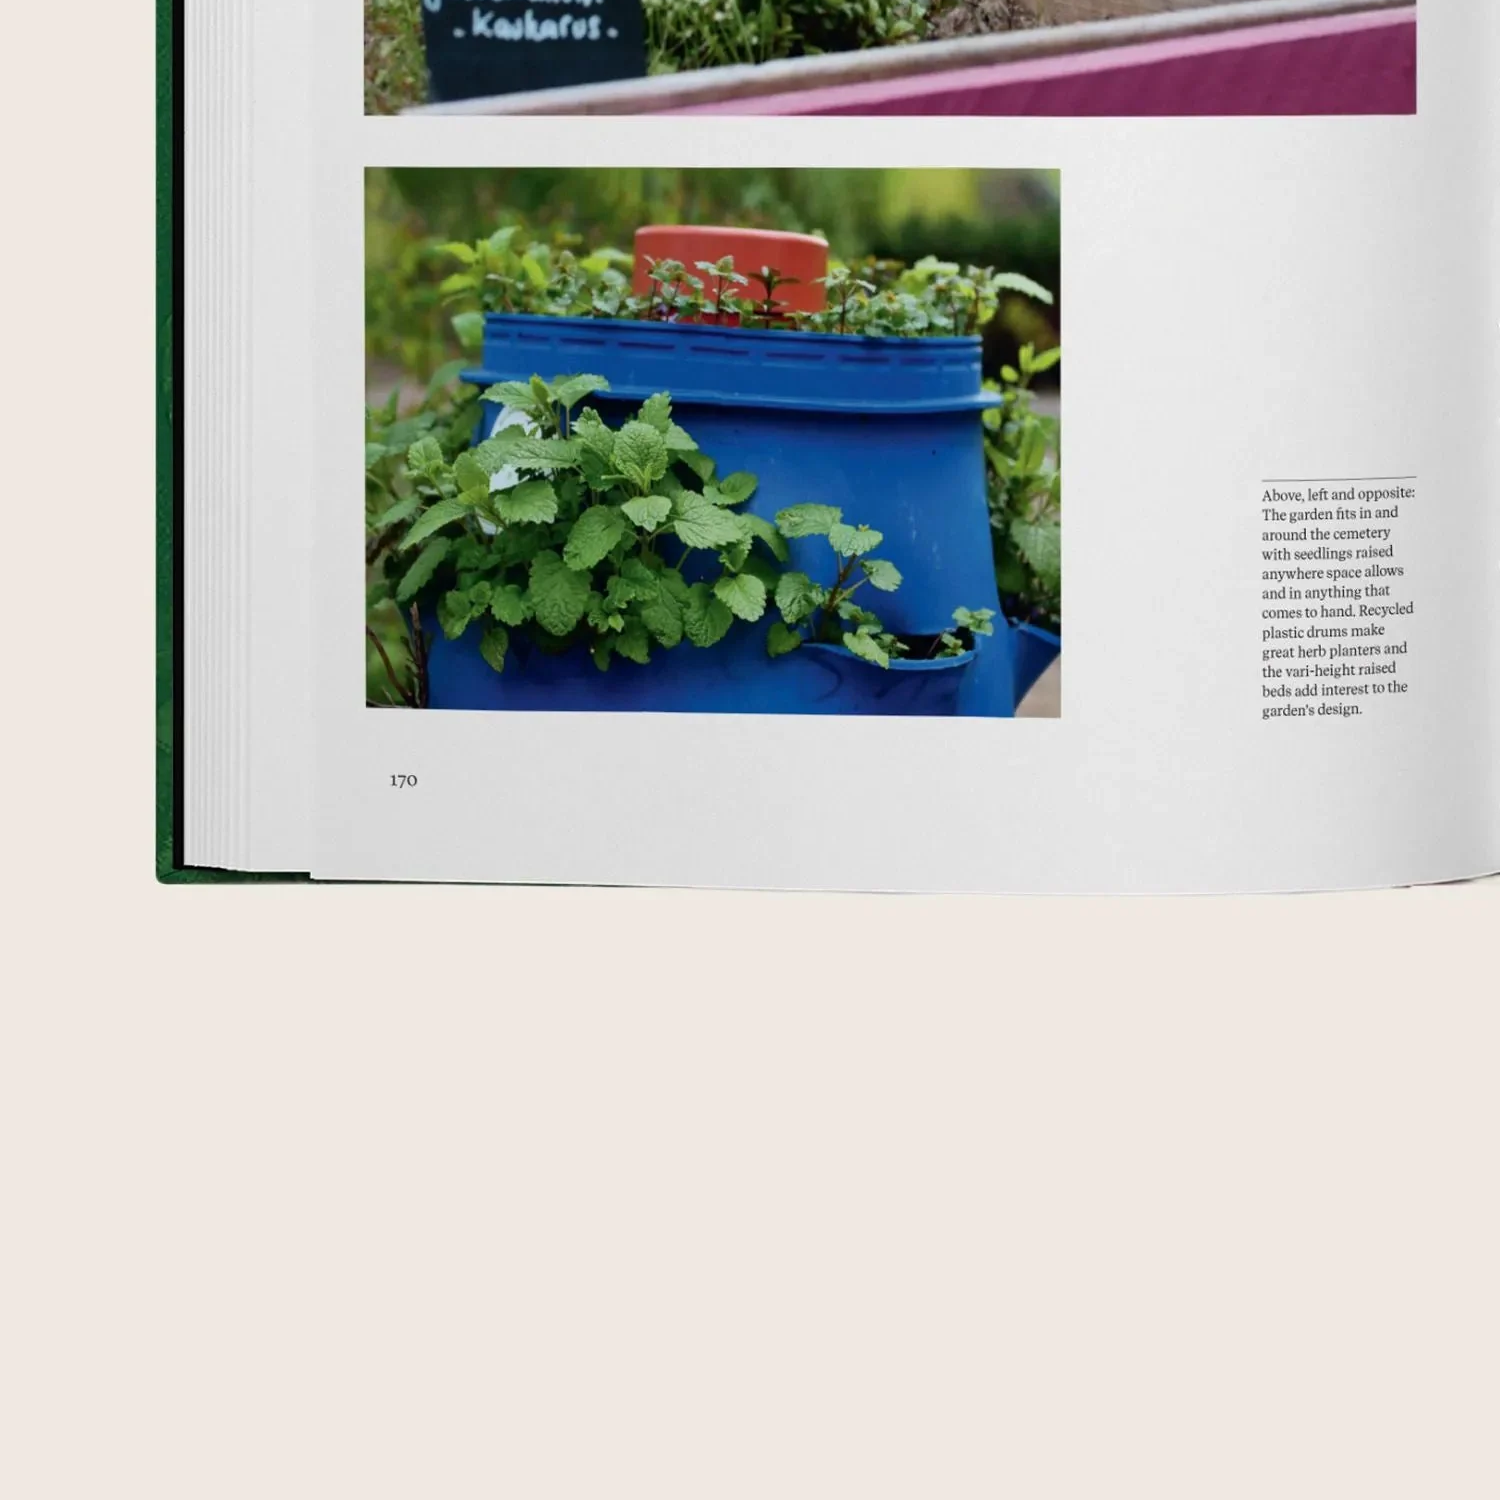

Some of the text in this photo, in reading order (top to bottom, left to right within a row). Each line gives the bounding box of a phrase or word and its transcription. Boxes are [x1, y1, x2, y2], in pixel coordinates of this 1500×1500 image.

[1262, 486, 1416, 503] Above, left and opposite:
[1262, 506, 1398, 523] The garden fits in and
[1262, 527, 1391, 541] around the cemetery
[1262, 545, 1394, 561] with seedlings raised
[1262, 565, 1404, 583] anywhere space allows
[1262, 585, 1390, 601] and in anything that
[1262, 602, 1414, 619] comes to hand. Recycled
[1262, 624, 1385, 641] plastic drums make
[1262, 642, 1407, 661] great herb planters and
[1262, 662, 1396, 679] the vari-height raised
[1262, 681, 1408, 697] beds add interest to the
[1262, 703, 1363, 719] garden's design.
[390, 774, 418, 789] 170
